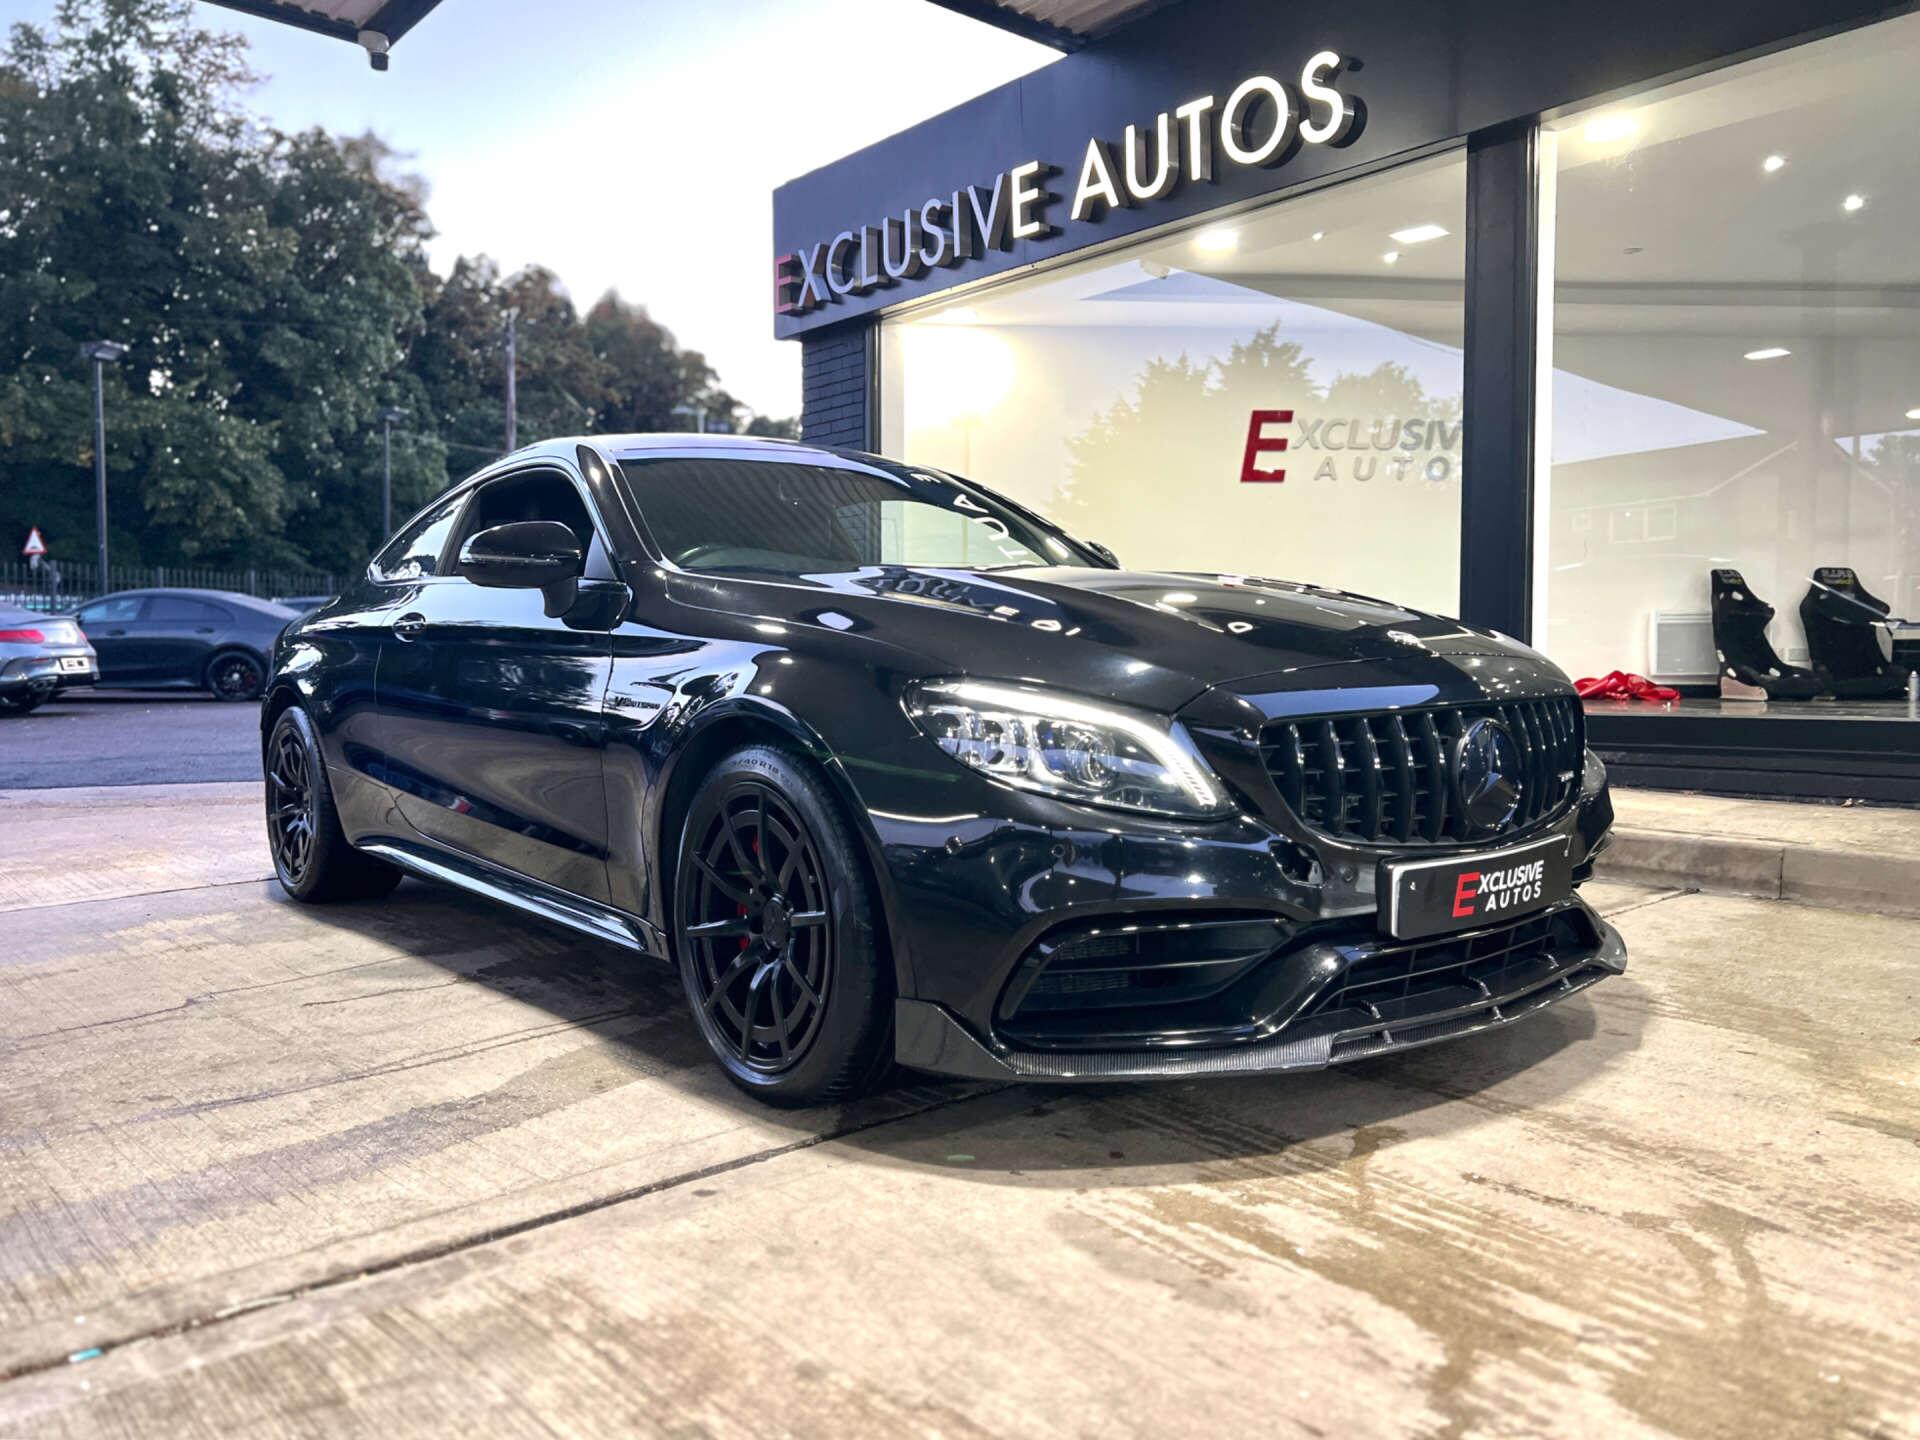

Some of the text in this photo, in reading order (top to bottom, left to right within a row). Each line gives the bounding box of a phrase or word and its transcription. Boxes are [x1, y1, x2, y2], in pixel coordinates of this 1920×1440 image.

[773, 50, 1347, 316] EXCLUSIVE AUTOS
[1240, 410, 1462, 483] EXCLUSIV
[1313, 455, 1451, 482] AUTO
[1452, 859, 1545, 918] EXCLUSIVE
[1485, 881, 1542, 912] AUTOS
